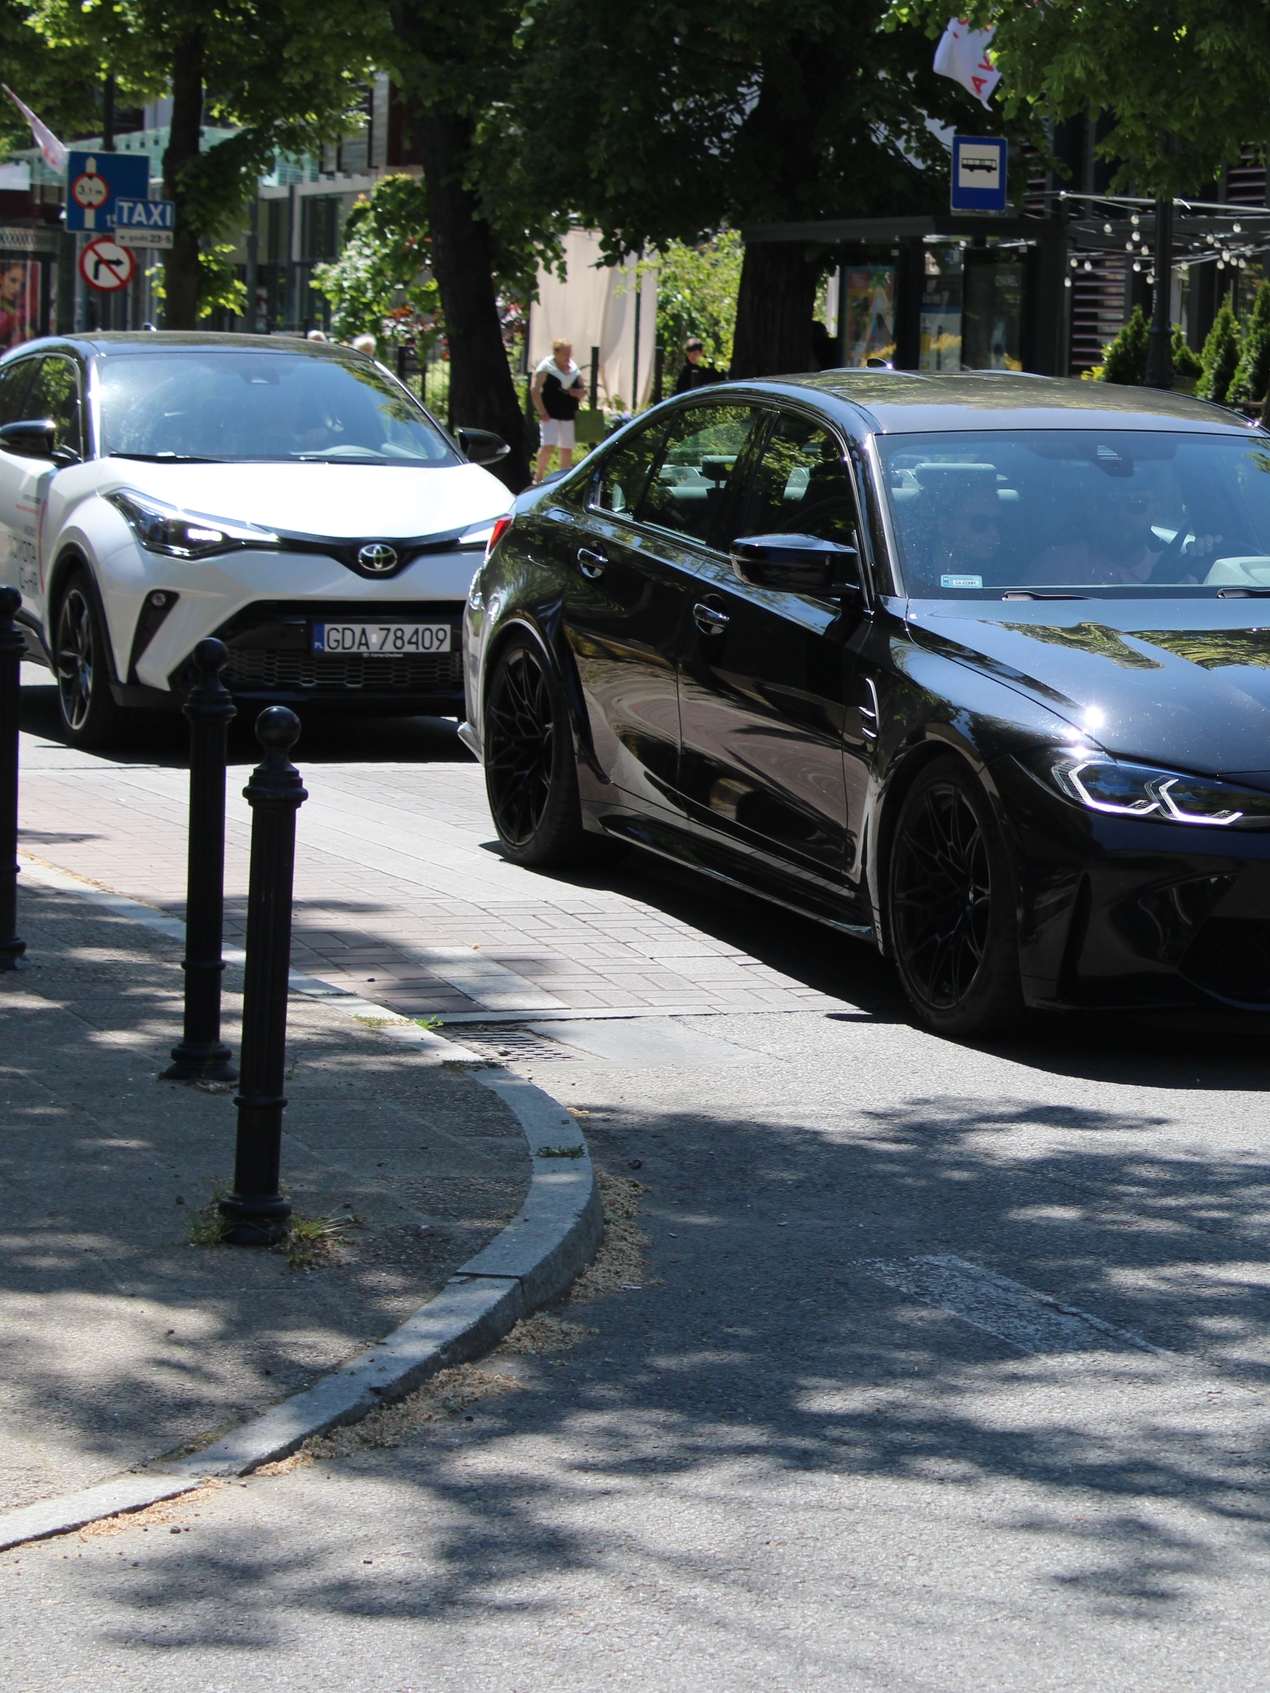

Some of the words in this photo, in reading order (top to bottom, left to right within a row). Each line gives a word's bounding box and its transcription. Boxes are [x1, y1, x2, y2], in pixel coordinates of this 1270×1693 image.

[118, 201, 171, 227] TAXI
[327, 627, 370, 651] GDA
[378, 627, 448, 651] 78409
